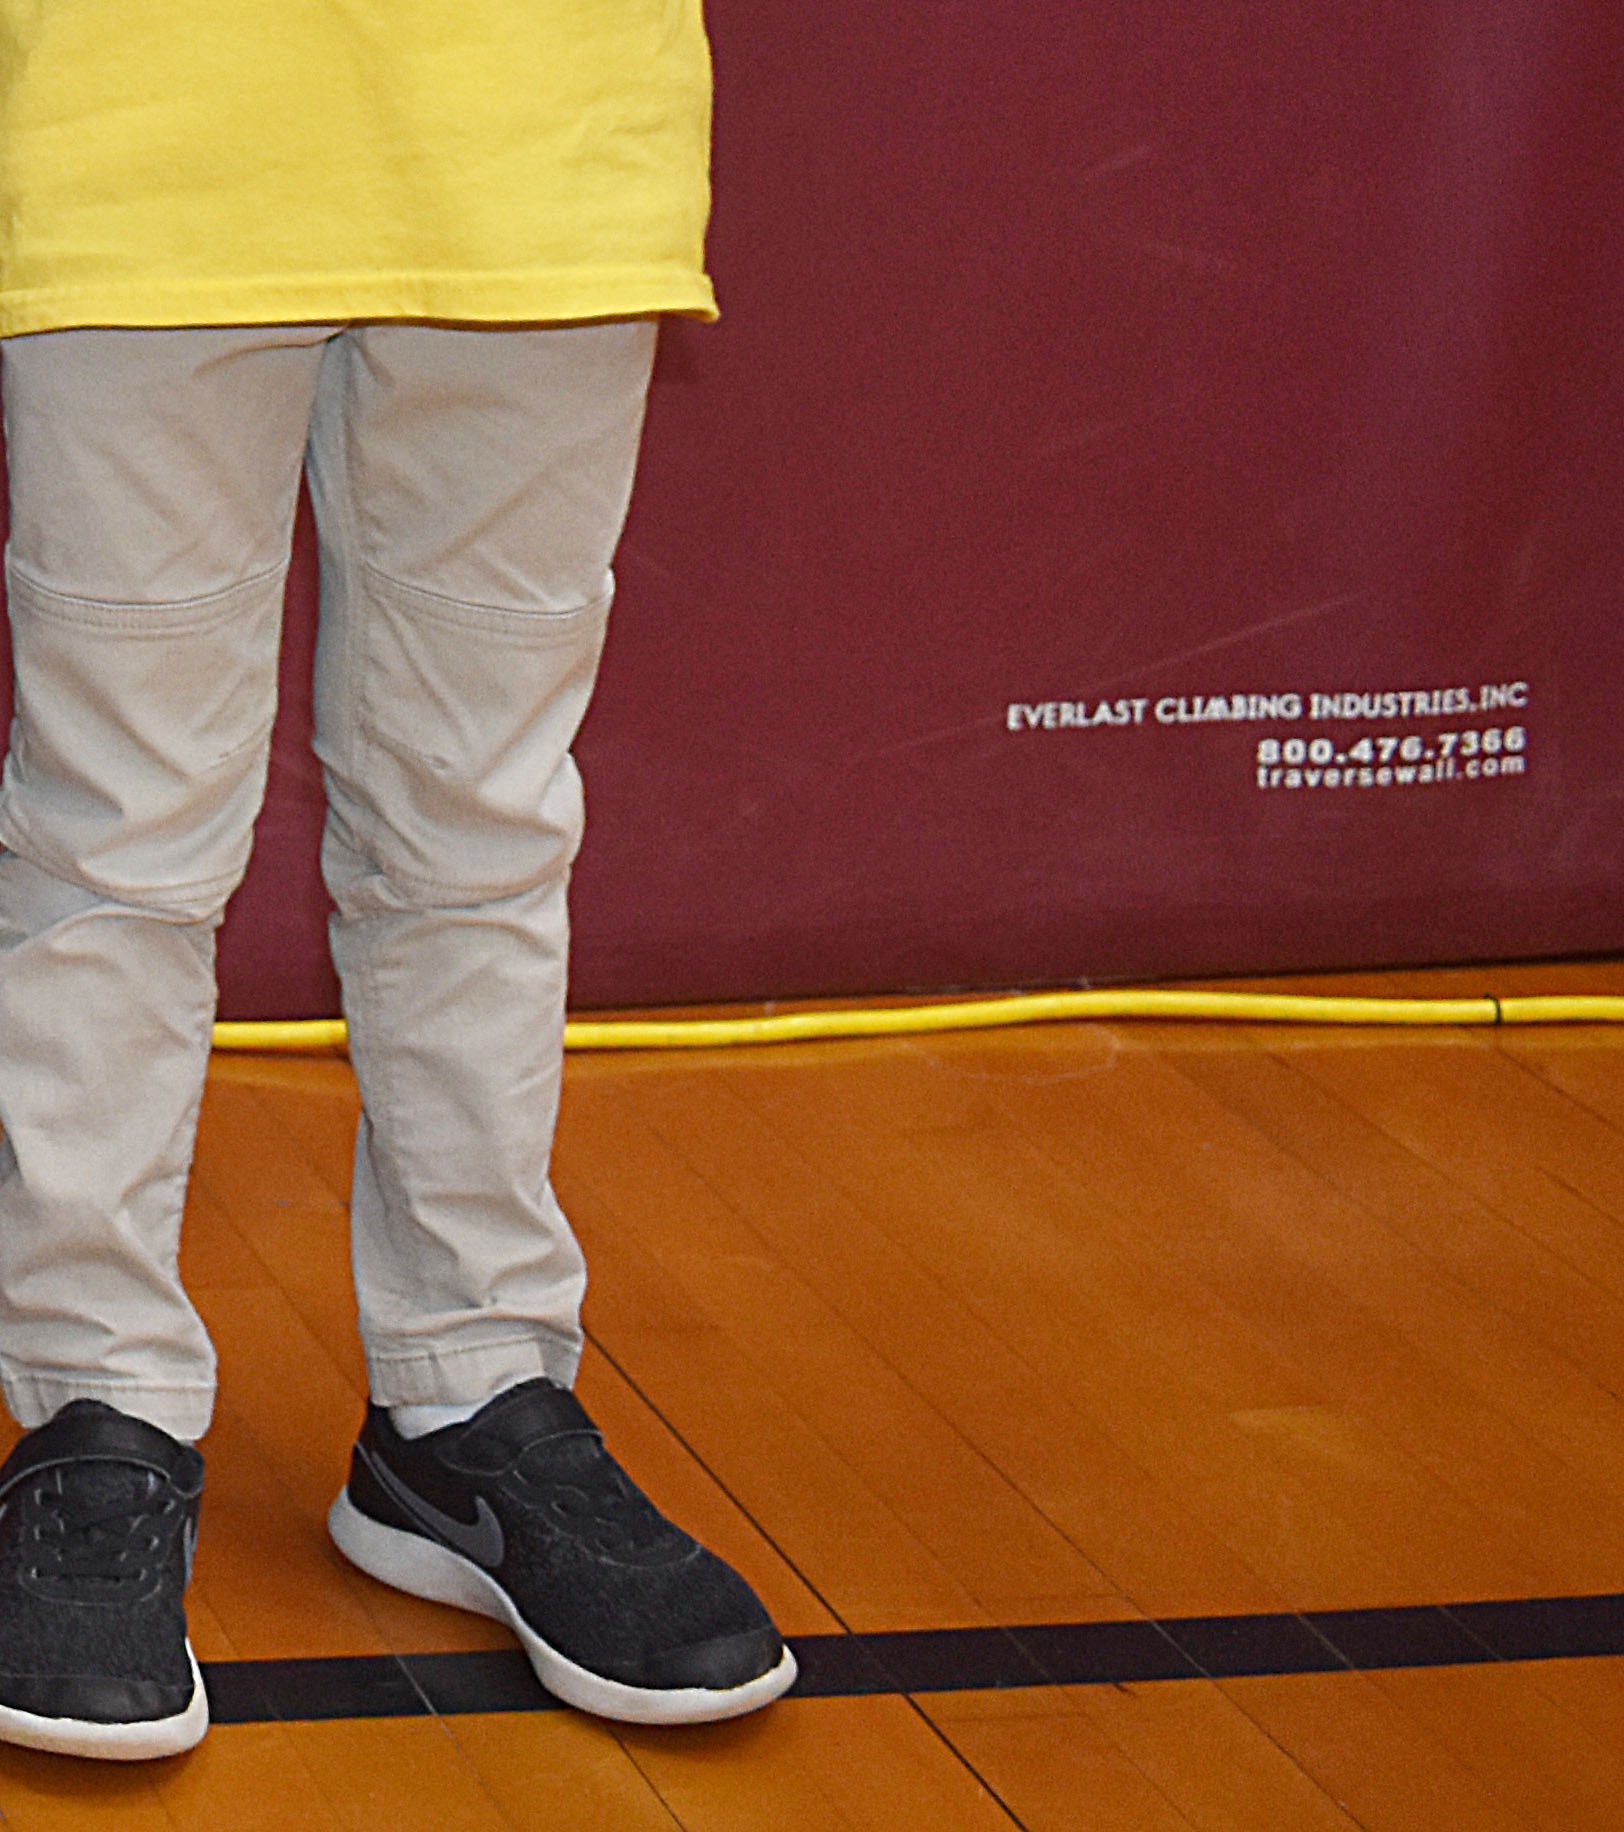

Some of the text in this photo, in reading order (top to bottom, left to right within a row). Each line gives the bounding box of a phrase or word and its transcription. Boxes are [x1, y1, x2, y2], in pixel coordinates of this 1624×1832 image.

[1007, 698, 1149, 731] EVERLAST
[1154, 692, 1302, 723] CLIMBING
[1256, 754, 1526, 790] traversewall.com
